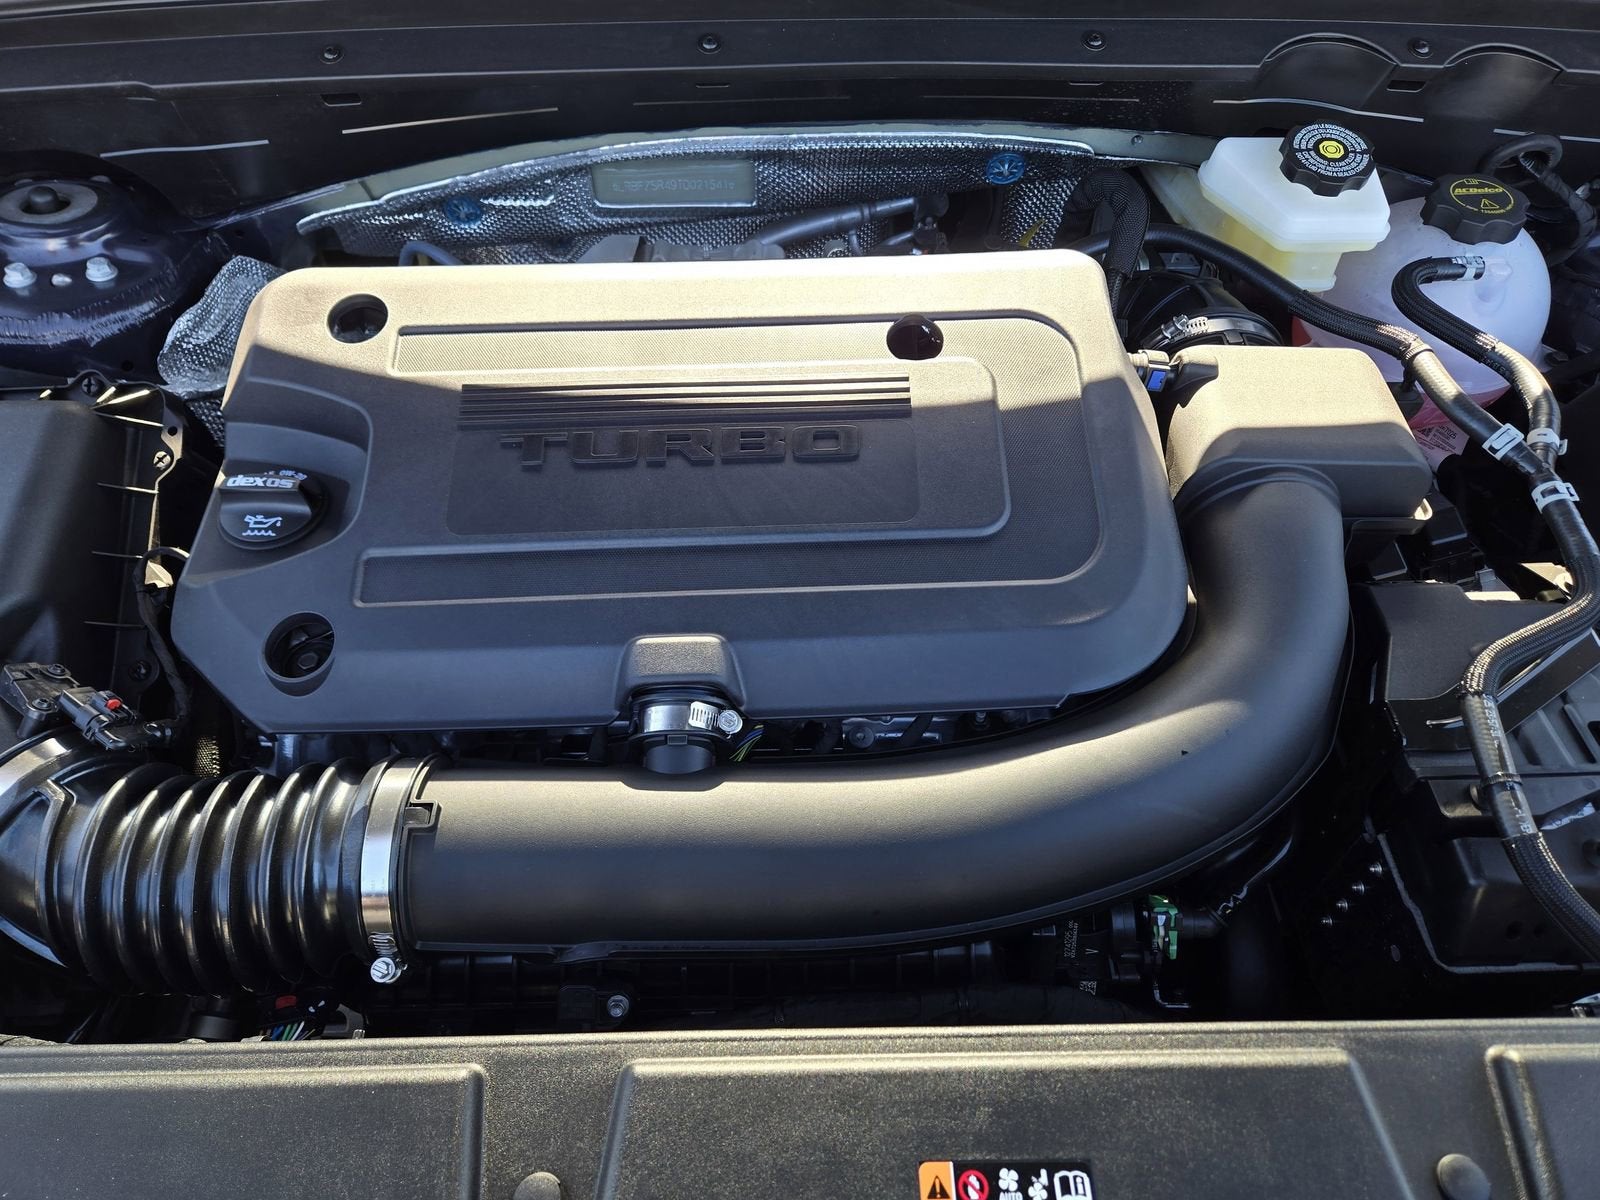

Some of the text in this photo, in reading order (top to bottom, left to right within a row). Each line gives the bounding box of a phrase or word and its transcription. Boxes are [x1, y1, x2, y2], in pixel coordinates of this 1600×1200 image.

[499, 424, 861, 470] TURBO
[226, 474, 296, 488] dexos
[999, 1191, 1023, 1200] AUTO
